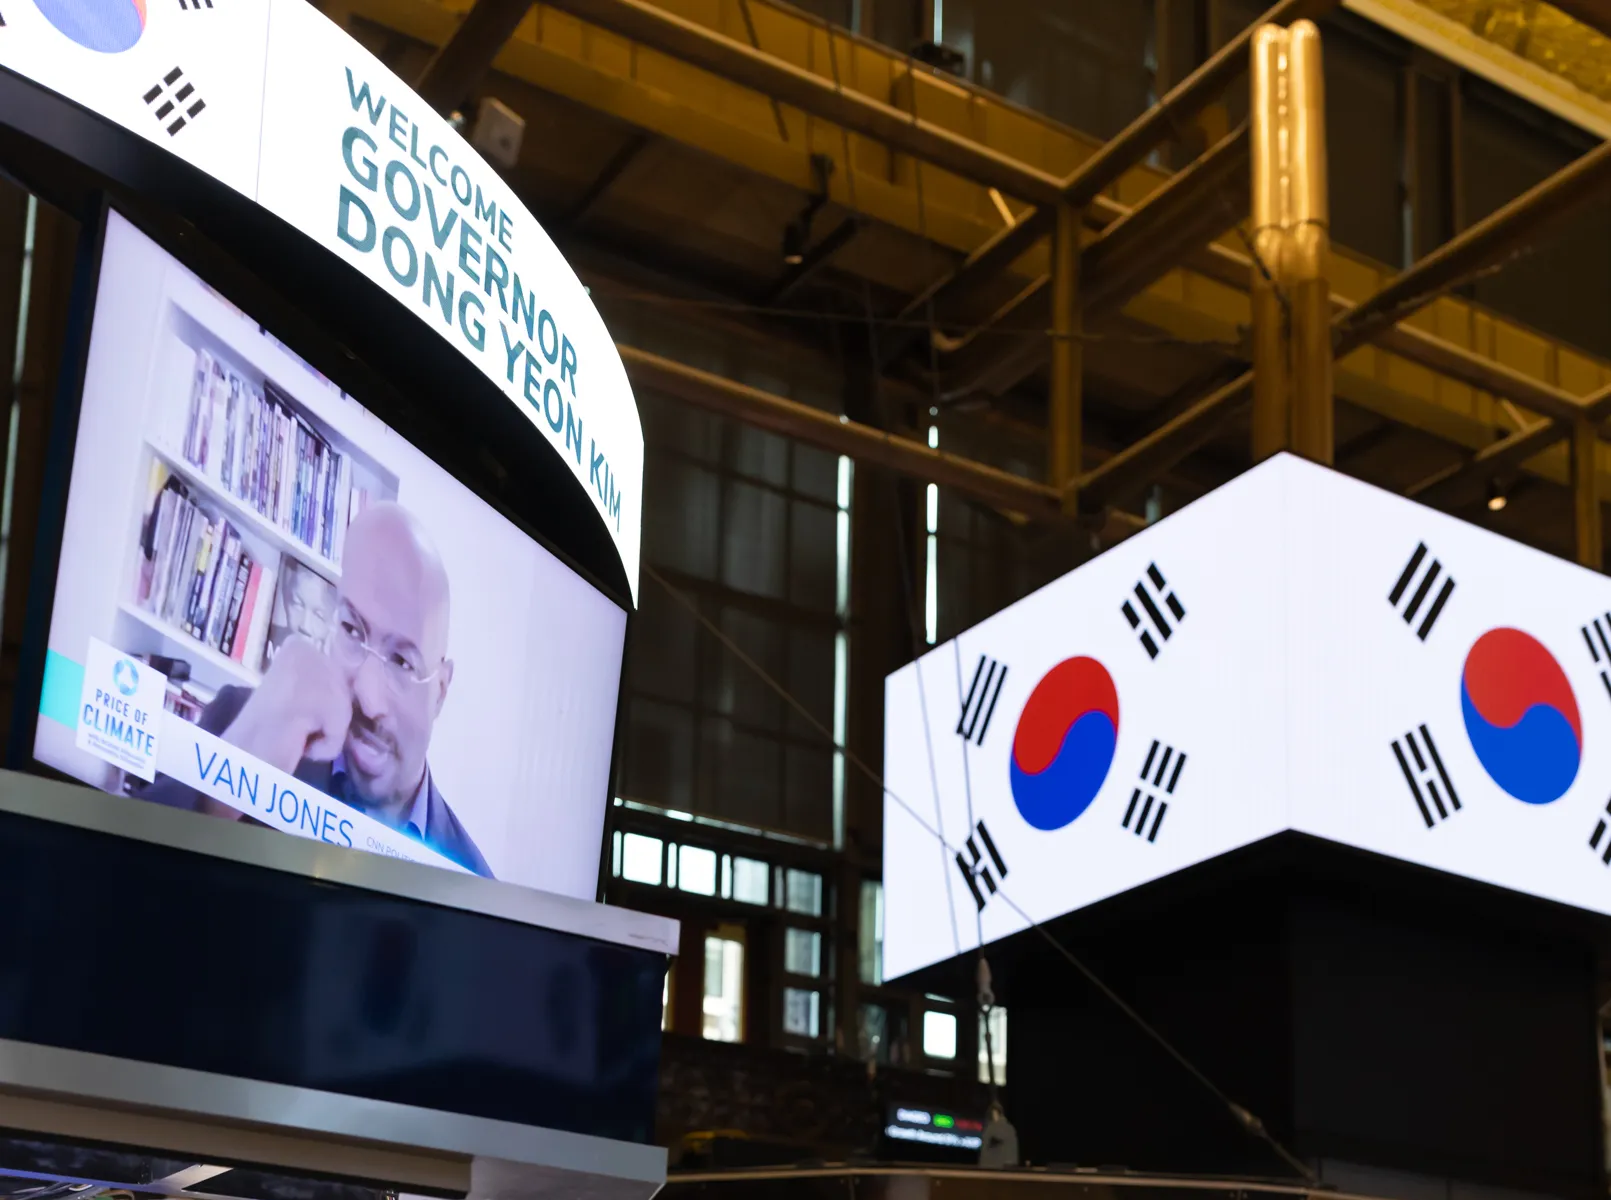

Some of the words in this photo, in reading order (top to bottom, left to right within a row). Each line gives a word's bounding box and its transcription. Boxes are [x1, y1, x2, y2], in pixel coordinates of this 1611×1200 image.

[345, 66, 513, 254] WELCOME
[342, 127, 578, 399] GOVERNOR
[337, 184, 487, 353] DONG
[499, 319, 583, 466] YEON
[590, 437, 621, 533] KIM
[83, 703, 154, 756] CLIMATE
[96, 688, 130, 717] PRICE
[135, 709, 148, 725] OF
[195, 742, 259, 806] VAN
[265, 783, 353, 848] JONES
